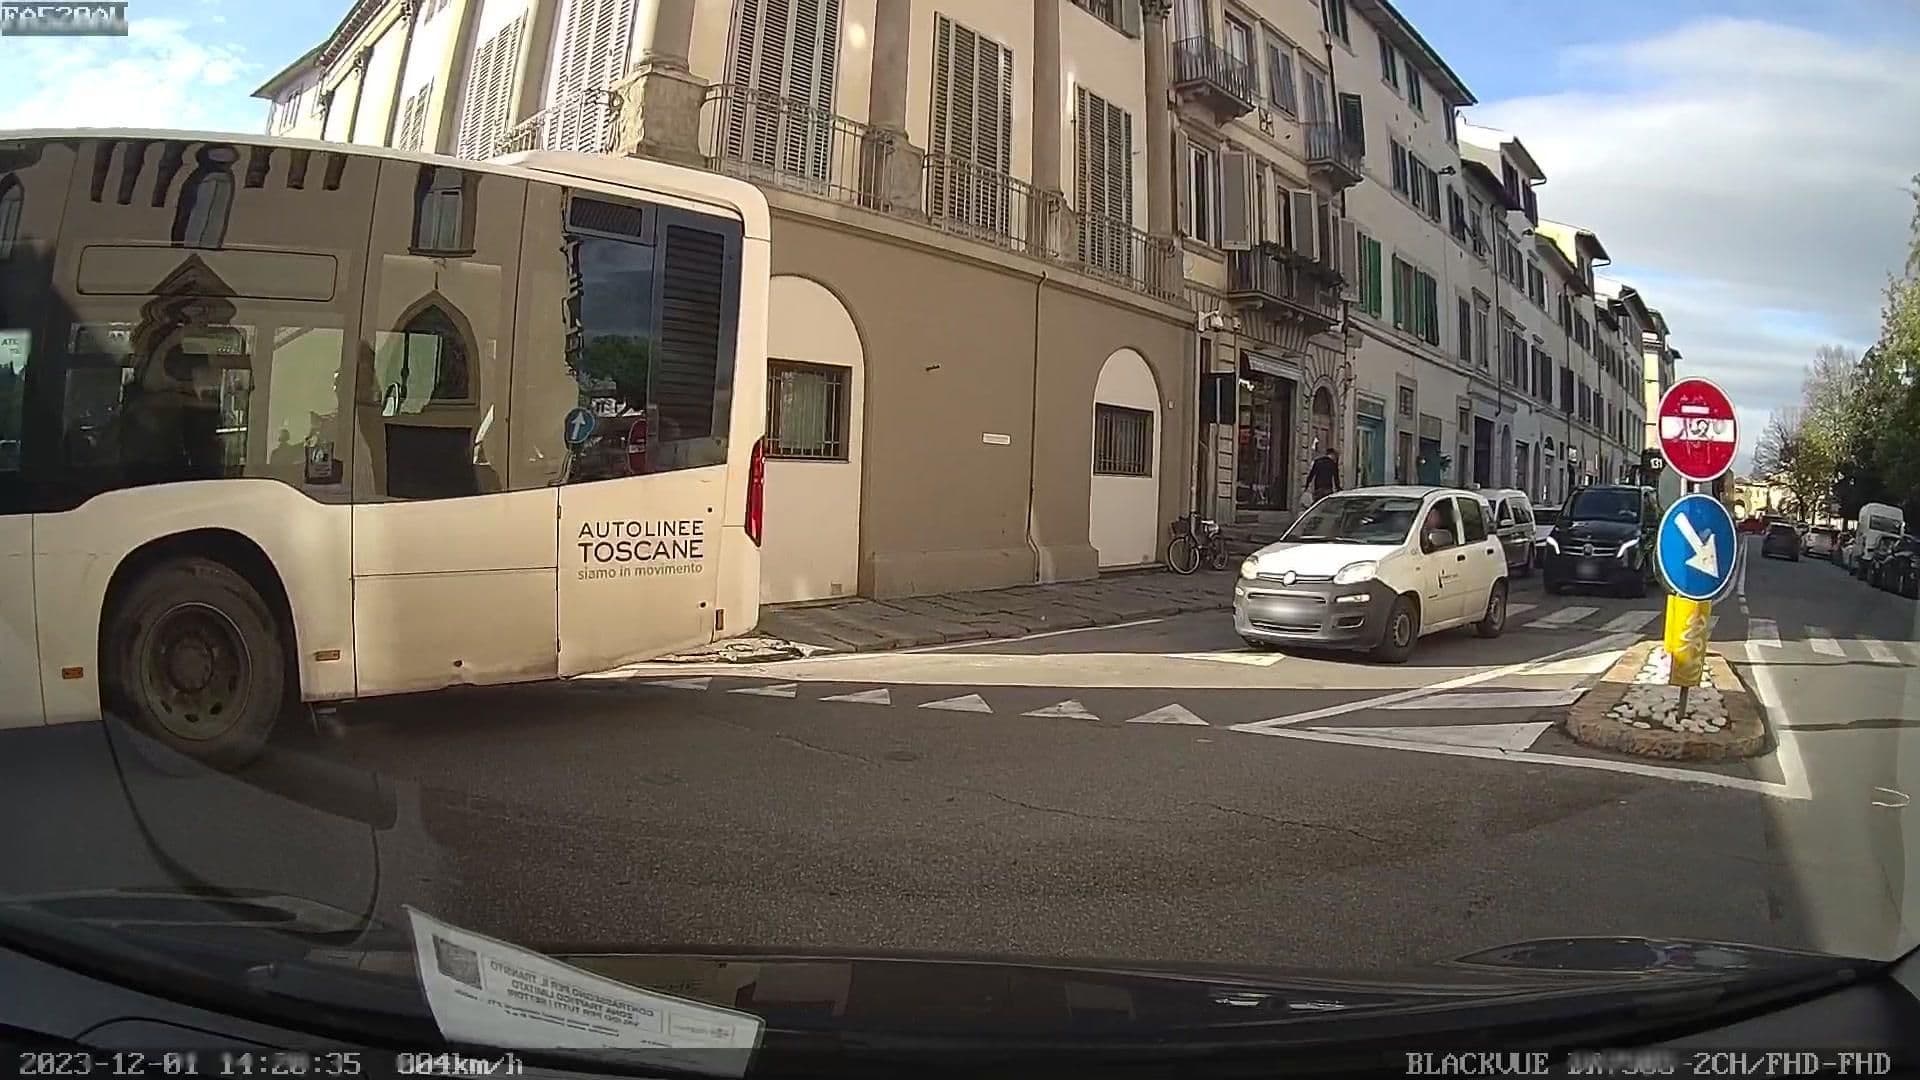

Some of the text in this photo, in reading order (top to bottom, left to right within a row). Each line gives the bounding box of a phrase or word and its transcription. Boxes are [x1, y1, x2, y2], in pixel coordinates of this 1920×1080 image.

[578, 520, 704, 538] AUTOLINEE
[577, 540, 704, 563] TOSCANE
[577, 563, 703, 580] siamo in movimento
